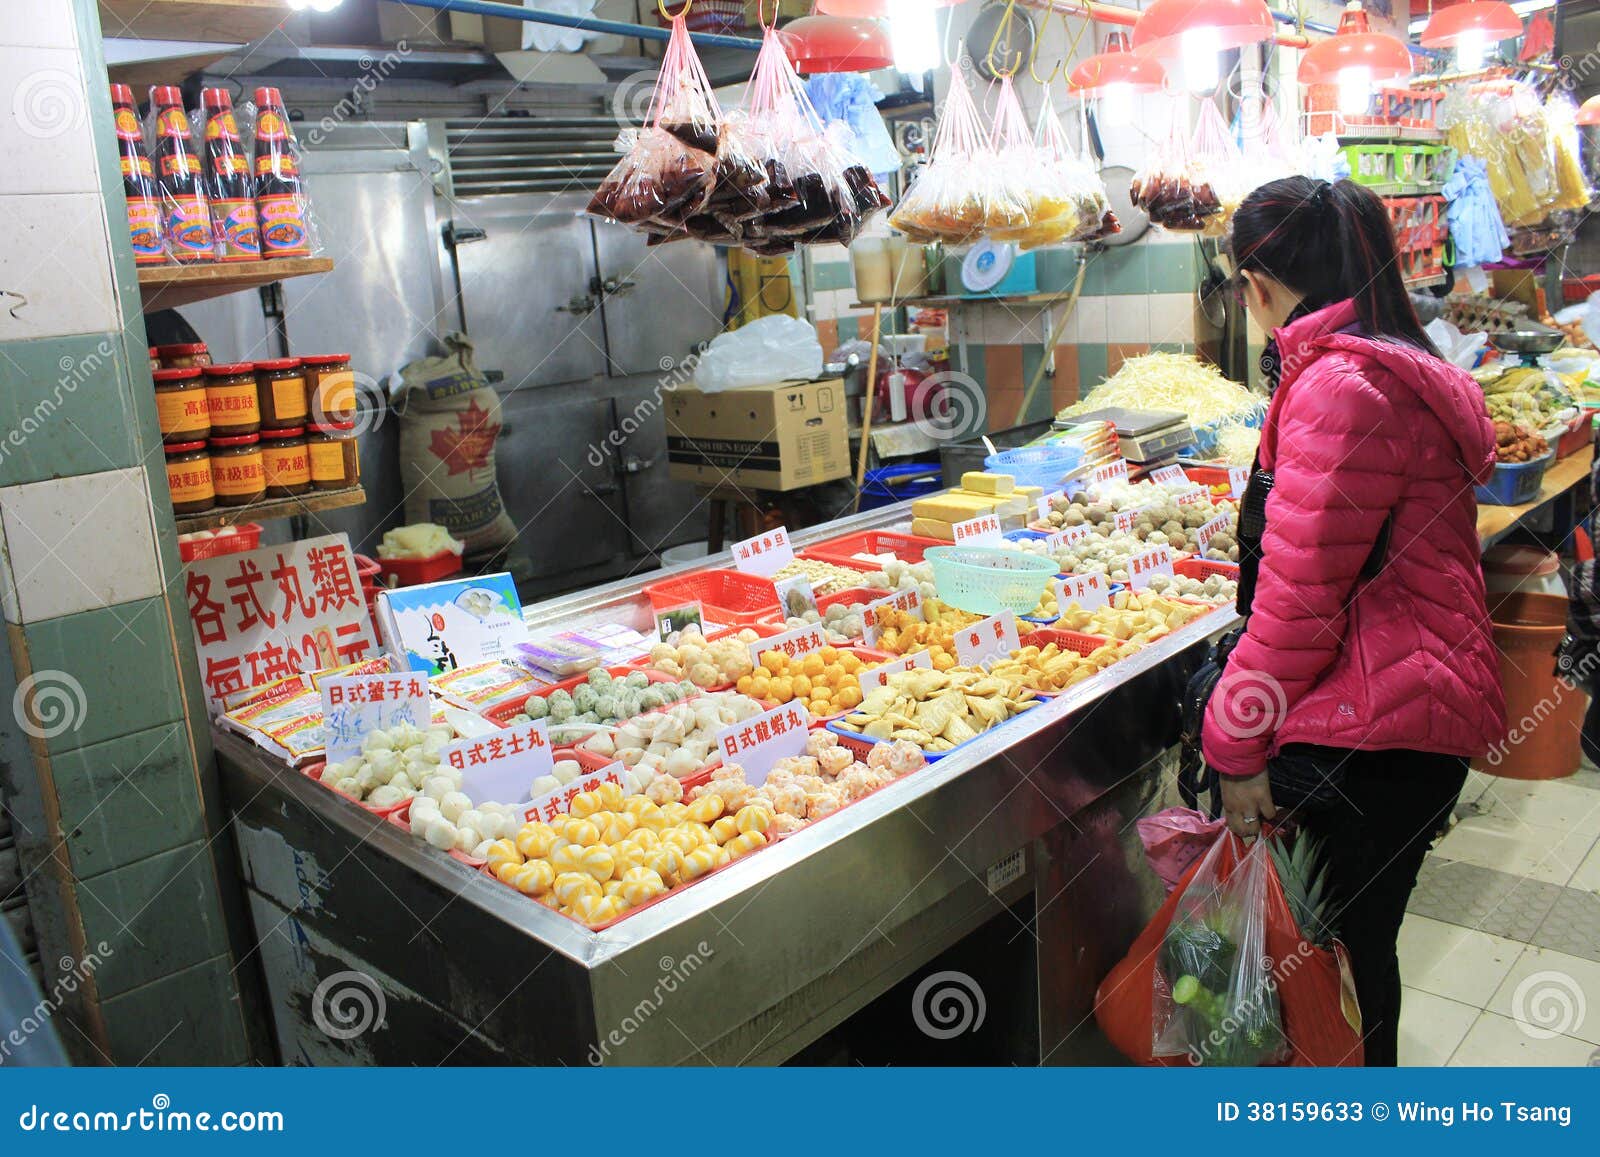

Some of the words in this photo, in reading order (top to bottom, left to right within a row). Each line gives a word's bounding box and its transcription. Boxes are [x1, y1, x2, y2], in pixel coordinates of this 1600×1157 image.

[186, 544, 360, 646] 各式丸類
[329, 678, 424, 705] 日式蟹子丸
[448, 727, 545, 769] 日式芝士丸
[723, 708, 803, 757] 日式龍蝦丸
